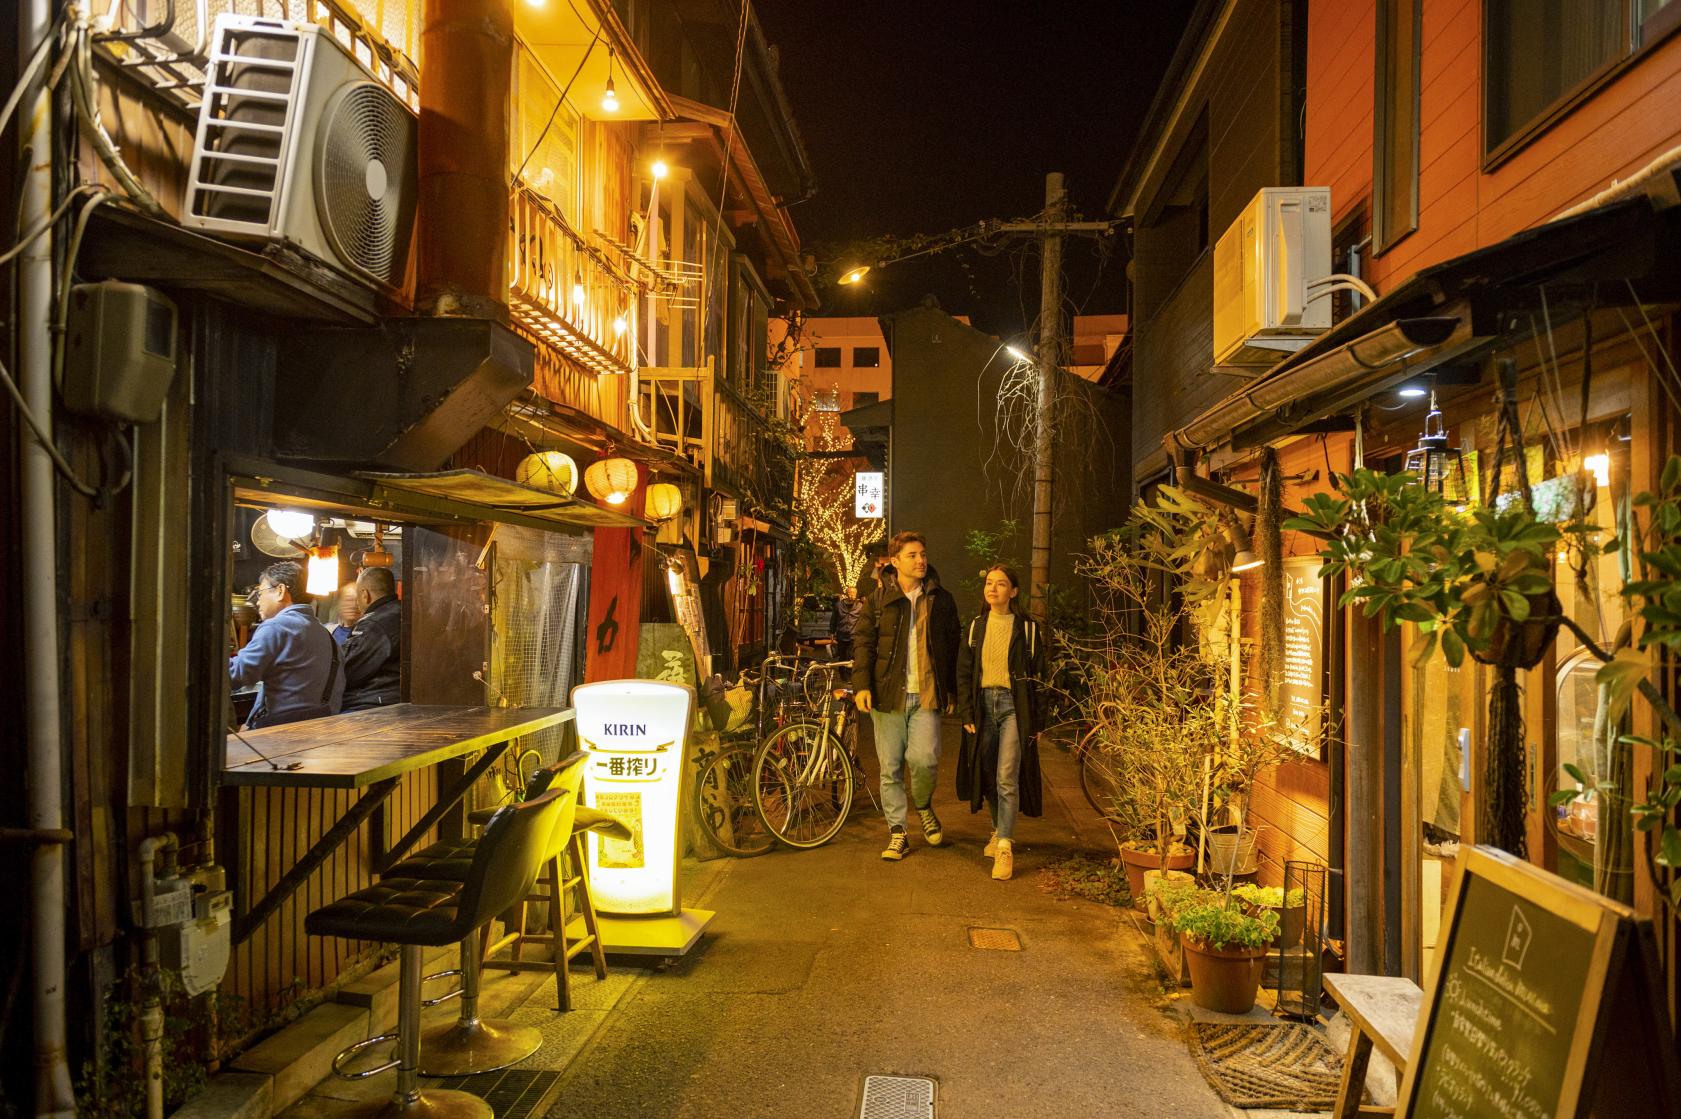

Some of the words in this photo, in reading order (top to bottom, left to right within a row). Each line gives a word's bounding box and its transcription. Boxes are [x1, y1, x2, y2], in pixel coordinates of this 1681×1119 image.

[858, 483, 880, 500] 串幸
[604, 723, 646, 736] KIRIN
[596, 757, 657, 776] 一番搾り
